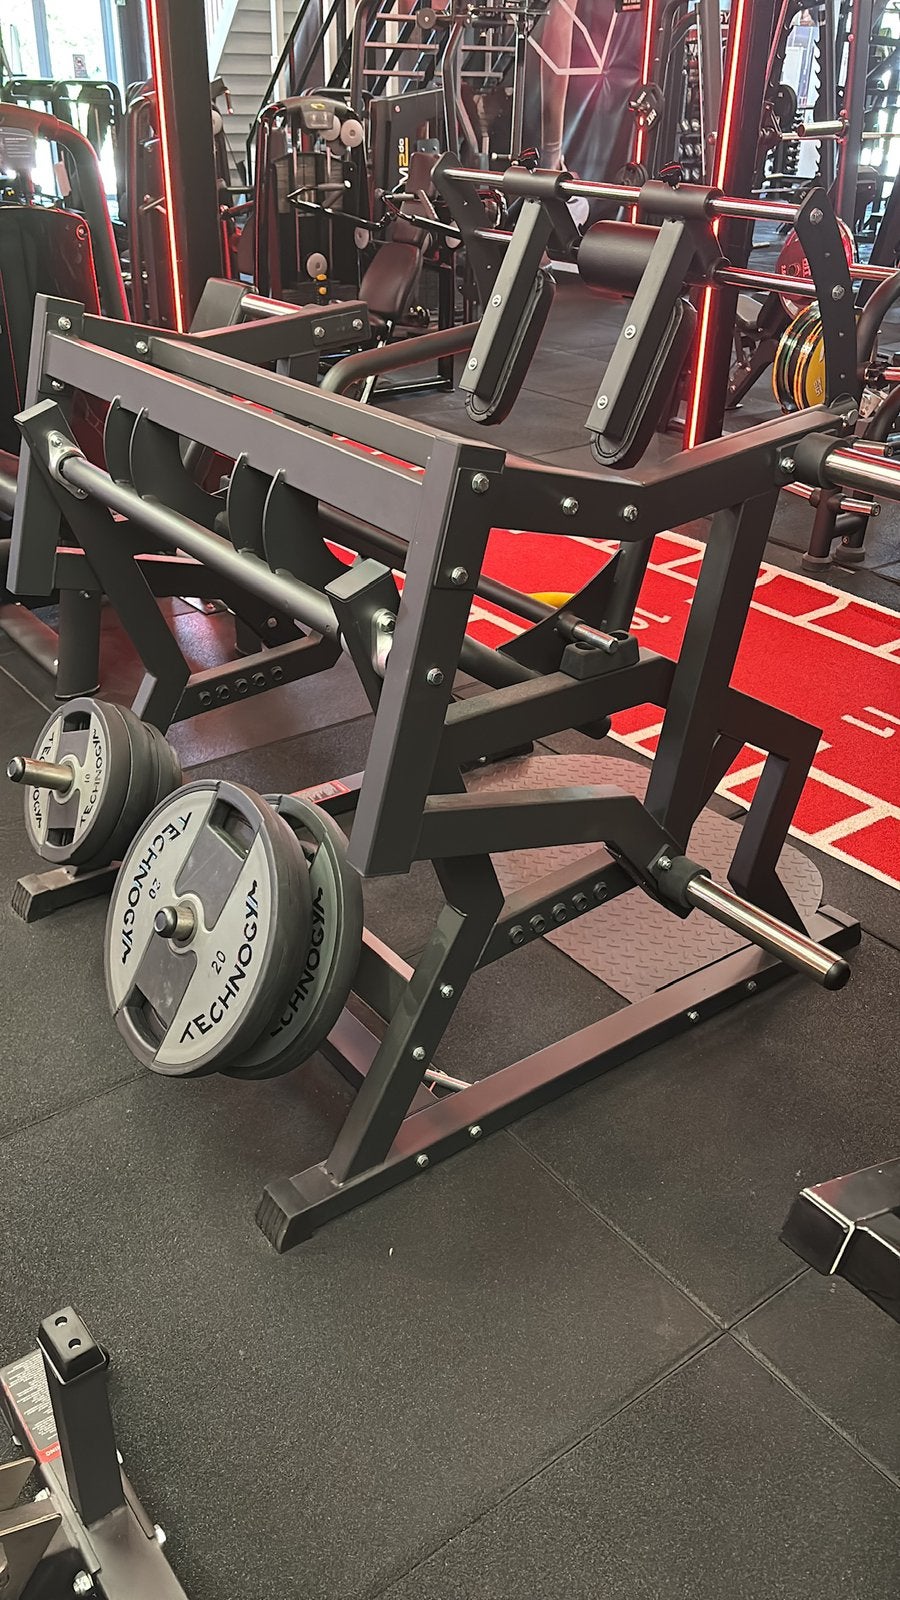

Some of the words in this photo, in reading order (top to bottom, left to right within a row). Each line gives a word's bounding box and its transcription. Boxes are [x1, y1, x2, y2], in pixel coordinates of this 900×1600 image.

[33, 731, 55, 829] TEOGYM
[80, 728, 103, 828] TECHNOGYM
[121, 811, 193, 966] TECHNOGYM
[148, 877, 161, 900] 20
[179, 879, 259, 1044] TECHNOGYM
[211, 950, 226, 976] 20
[270, 886, 325, 1038] CHNOGYM
